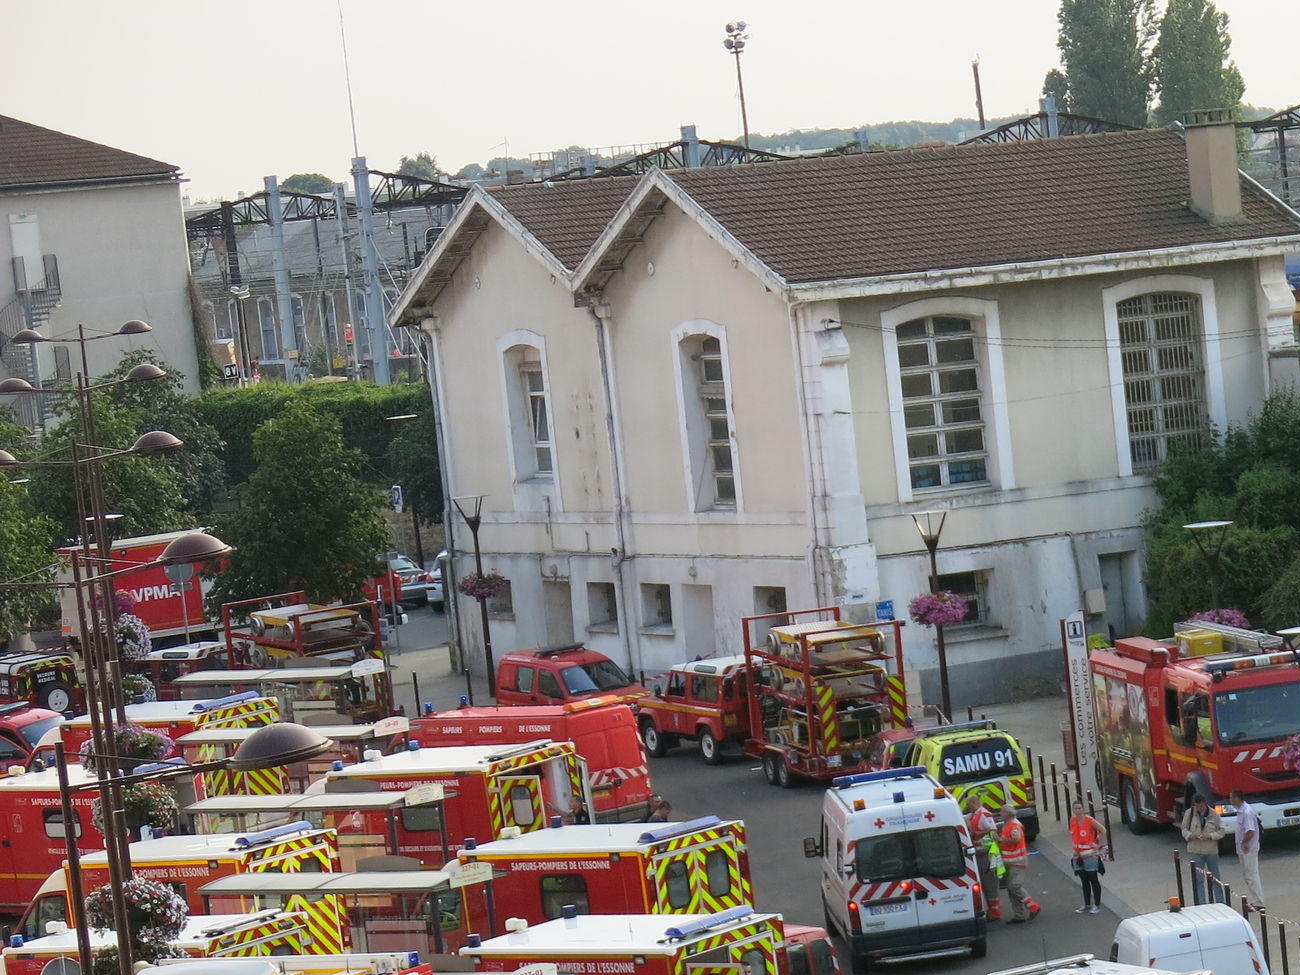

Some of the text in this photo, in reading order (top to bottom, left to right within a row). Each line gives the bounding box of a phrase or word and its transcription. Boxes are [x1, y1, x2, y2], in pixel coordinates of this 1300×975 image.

[36, 670, 56, 680] SECOURS
[1080, 657, 1091, 707] service
[1071, 657, 1088, 766] Les commerces
[442, 726, 463, 734] SAPEURS
[479, 725, 503, 734] POMPIERS
[518, 725, 526, 733] DE
[1086, 711, 1096, 748] votre
[943, 748, 1014, 776] SAMU 91
[511, 860, 610, 871] SAPEURS-POMPIERS DE L'ESSONNE
[169, 868, 176, 878] DE
[176, 867, 210, 878] L'ESSONNE
[588, 963, 597, 973] DE
[598, 962, 635, 974] L'ESSONNE
